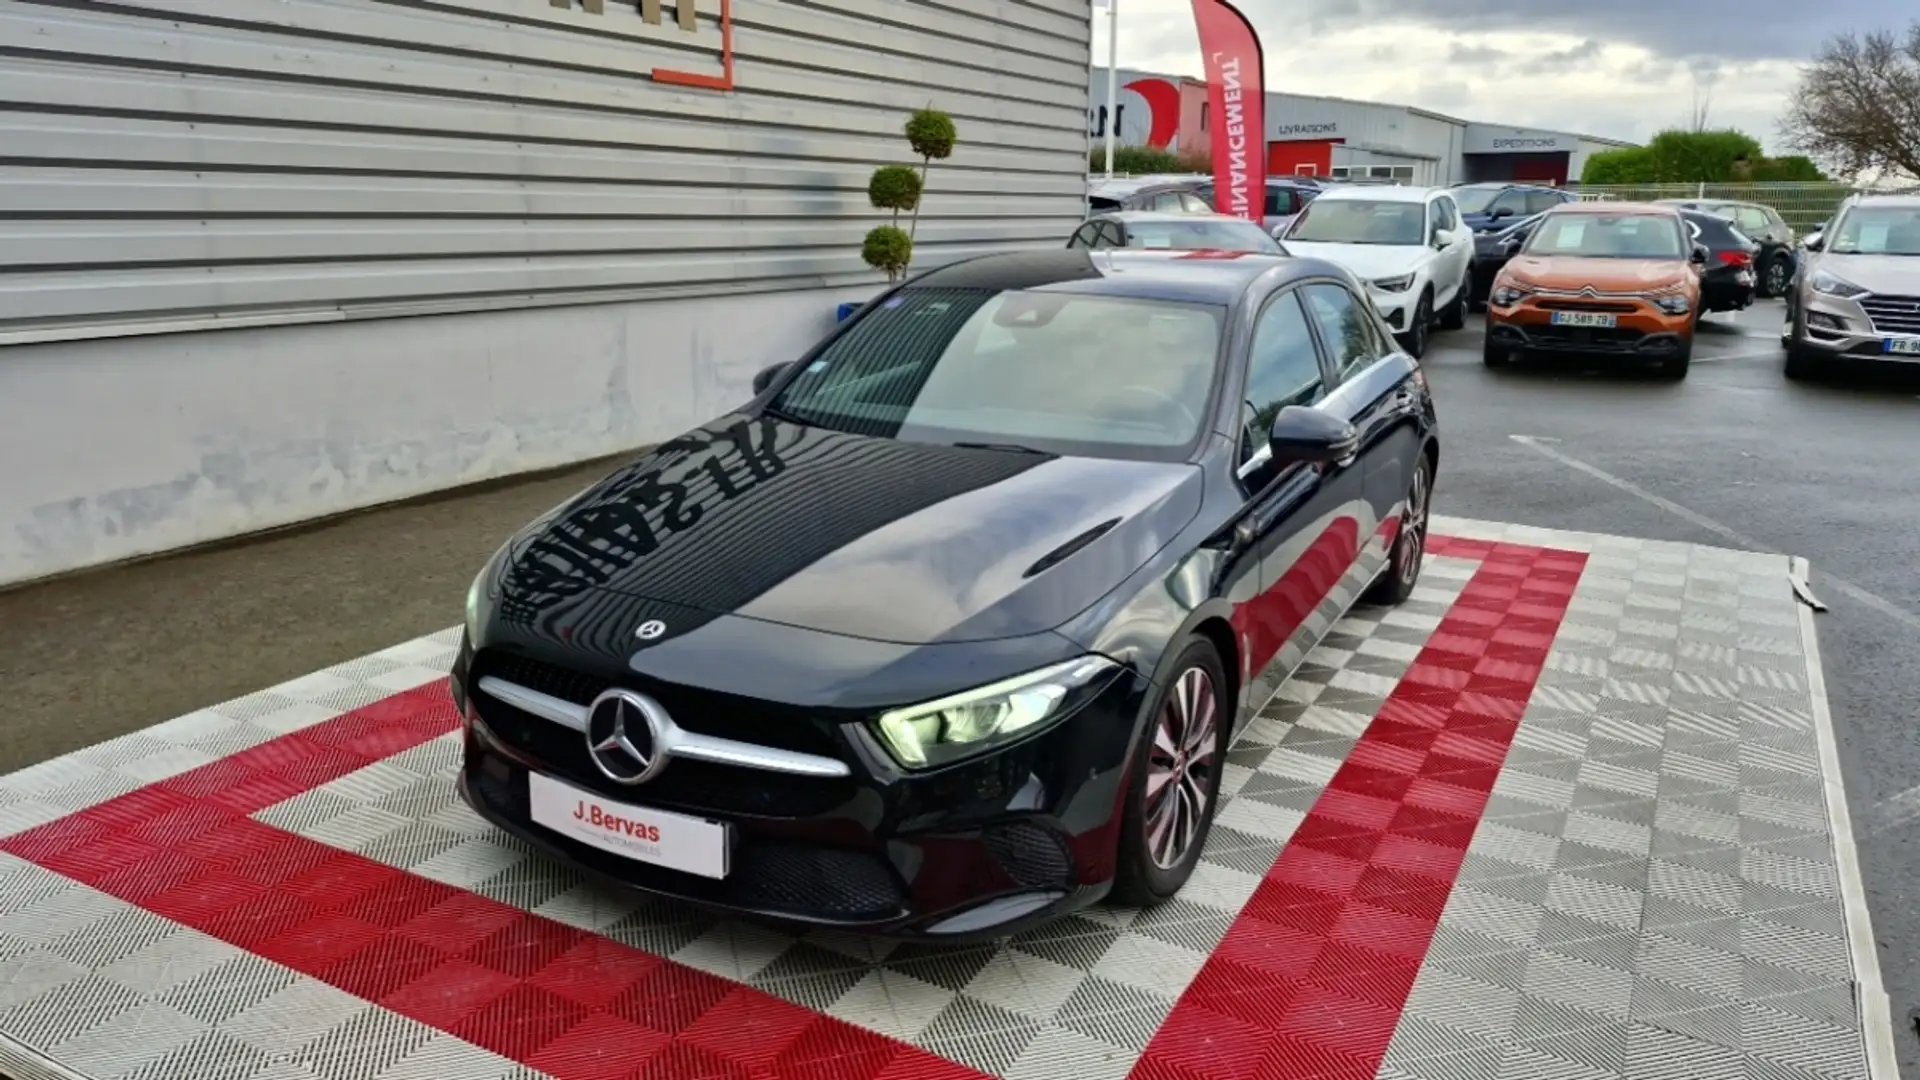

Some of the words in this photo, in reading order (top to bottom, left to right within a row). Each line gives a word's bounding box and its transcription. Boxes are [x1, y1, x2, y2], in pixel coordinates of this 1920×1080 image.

[1278, 122, 1337, 135] LIVRAISONS
[1493, 139, 1556, 149] EXPEDITIONS
[574, 800, 660, 842] J.Bervas
